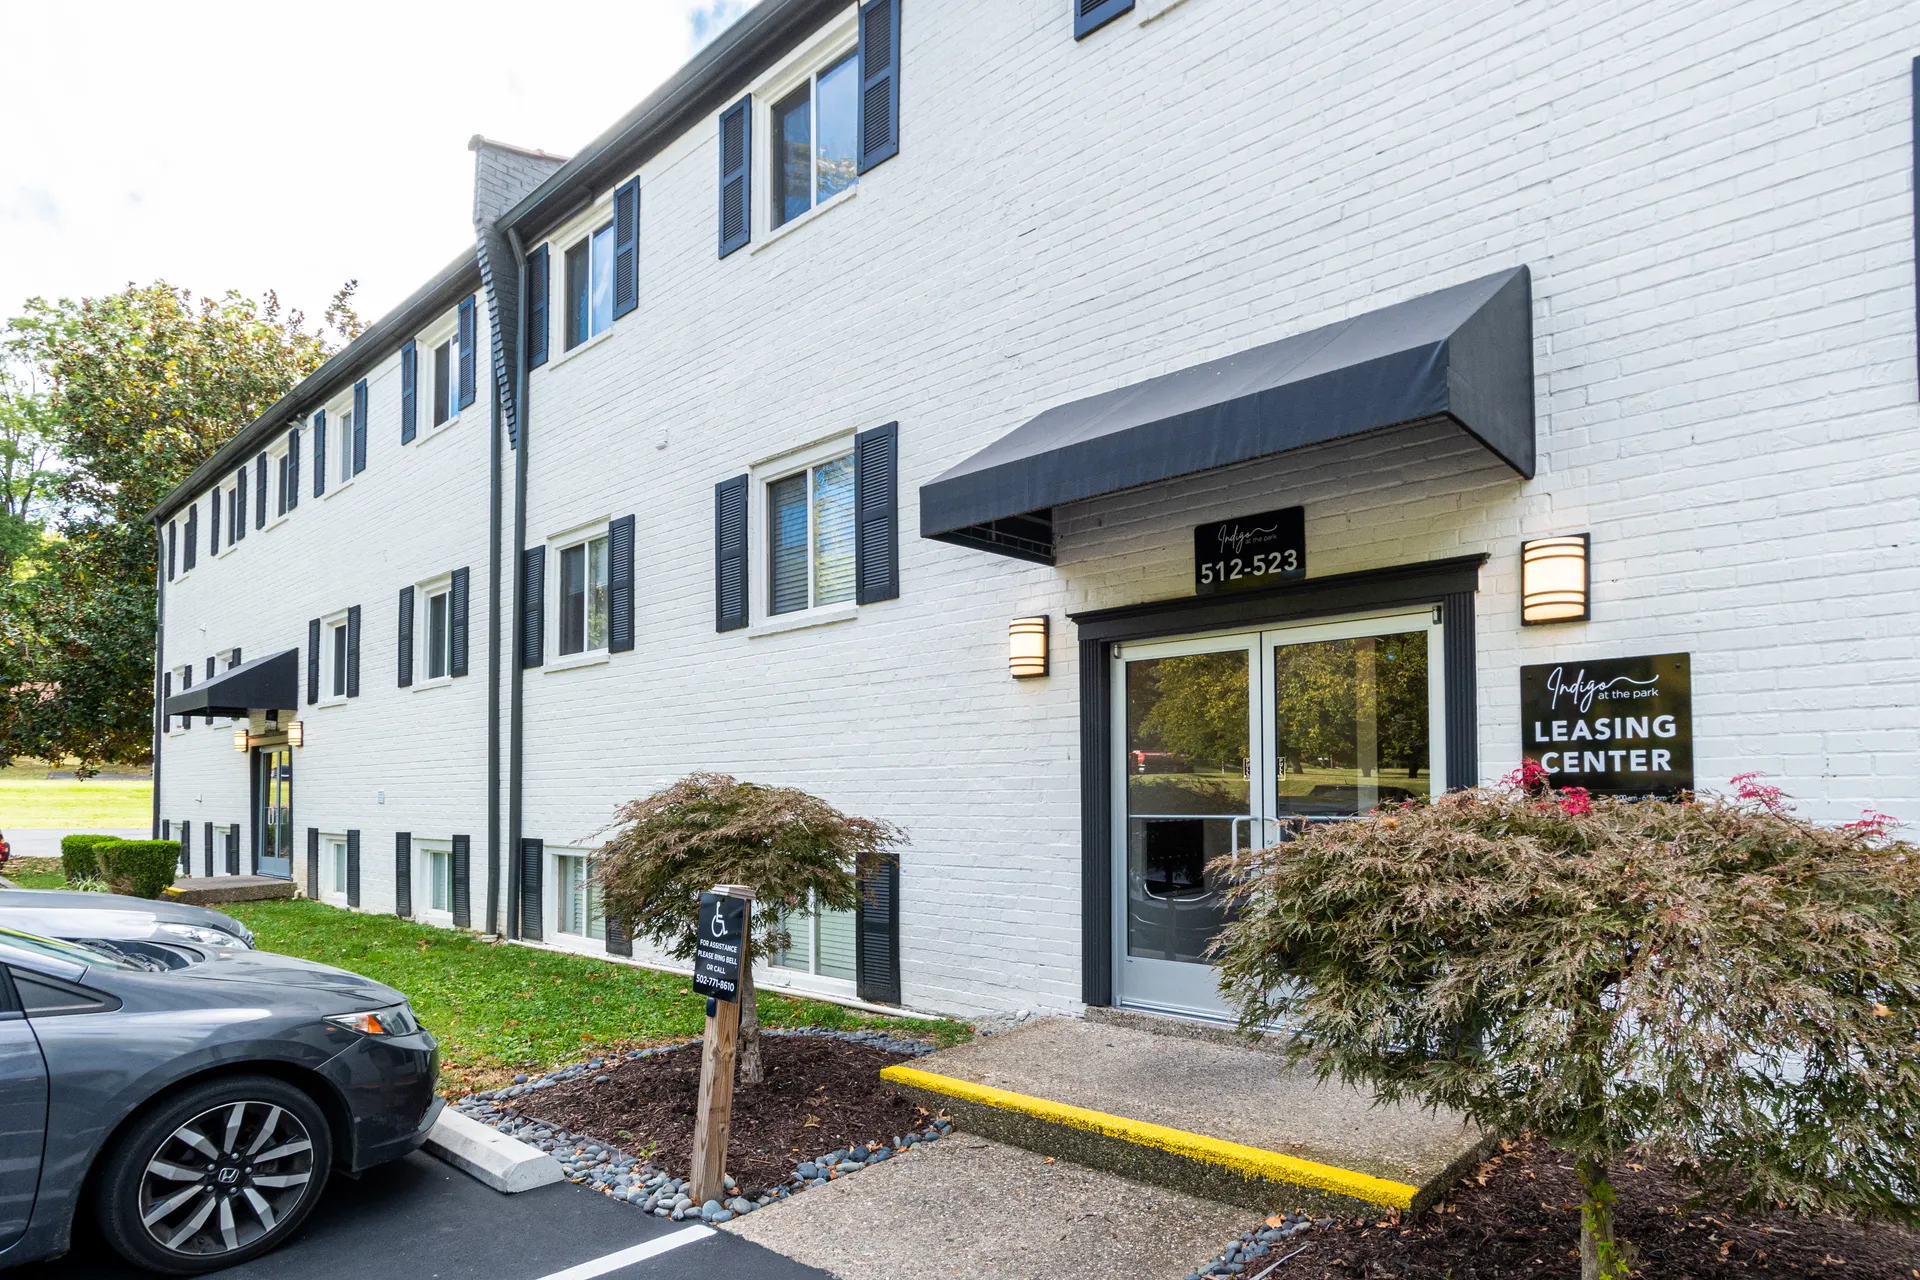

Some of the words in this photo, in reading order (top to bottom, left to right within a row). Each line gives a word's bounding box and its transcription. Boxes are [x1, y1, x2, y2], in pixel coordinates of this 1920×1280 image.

[1218, 524, 1278, 554] Indigo
[1263, 533, 1278, 542] park
[1200, 549, 1298, 584] 512-523
[1547, 666, 1660, 713] Indigo
[1597, 691, 1609, 700] at
[1611, 689, 1630, 699] the
[1633, 687, 1659, 699] park
[1534, 714, 1677, 743] LEASING
[1540, 748, 1672, 774] CENTER
[700, 939, 709, 947] FOR
[710, 941, 737, 953] ASSISTANCE
[698, 950, 714, 959] PLEASE
[714, 953, 725, 963] RING
[725, 956, 738, 965] BELL
[706, 963, 714, 972] OR
[714, 965, 726, 974] CALL
[696, 973, 735, 992] 502-771-8610
